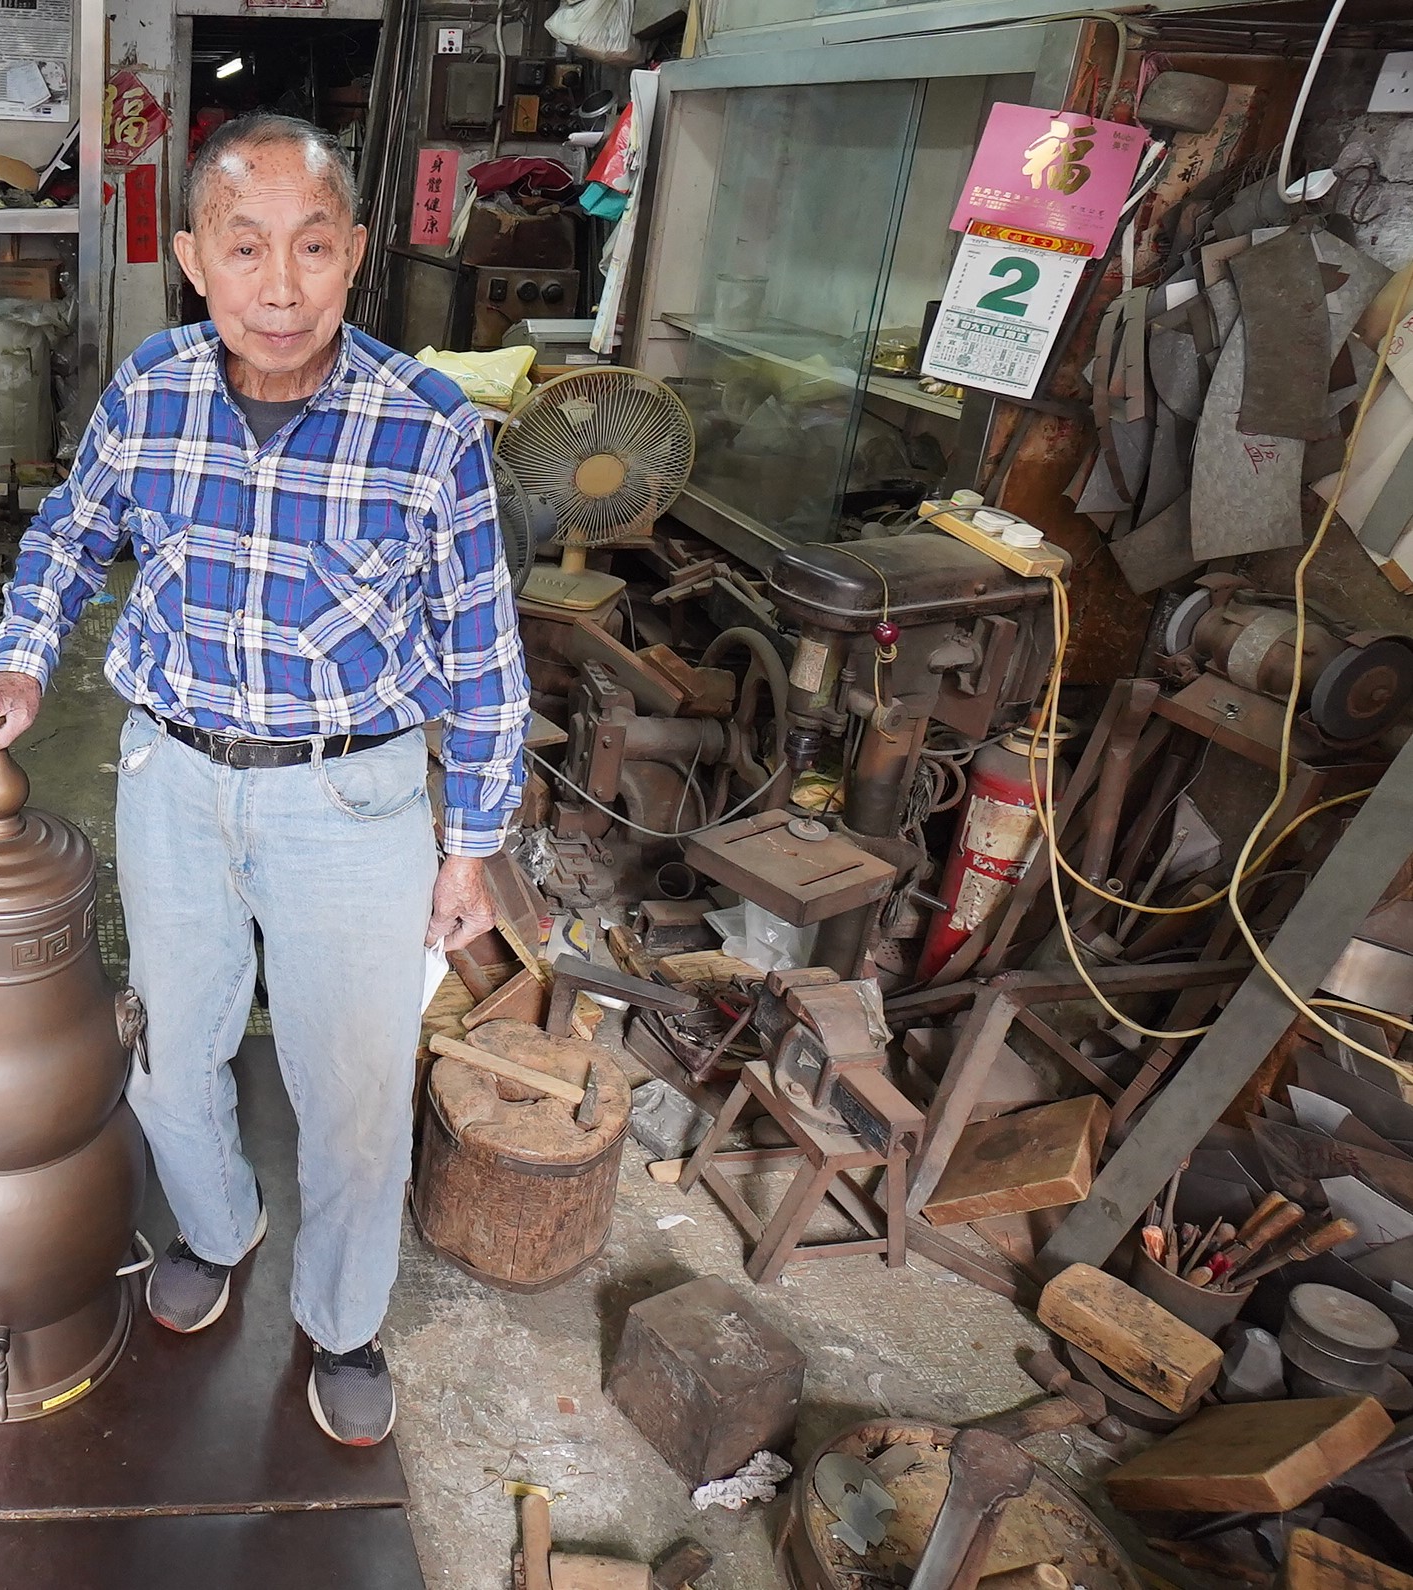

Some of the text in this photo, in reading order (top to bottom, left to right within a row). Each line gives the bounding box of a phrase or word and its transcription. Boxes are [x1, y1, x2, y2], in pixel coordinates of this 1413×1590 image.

[423, 154, 444, 234] 身體健康
[1022, 120, 1097, 195] 福
[976, 256, 1040, 317] 2
